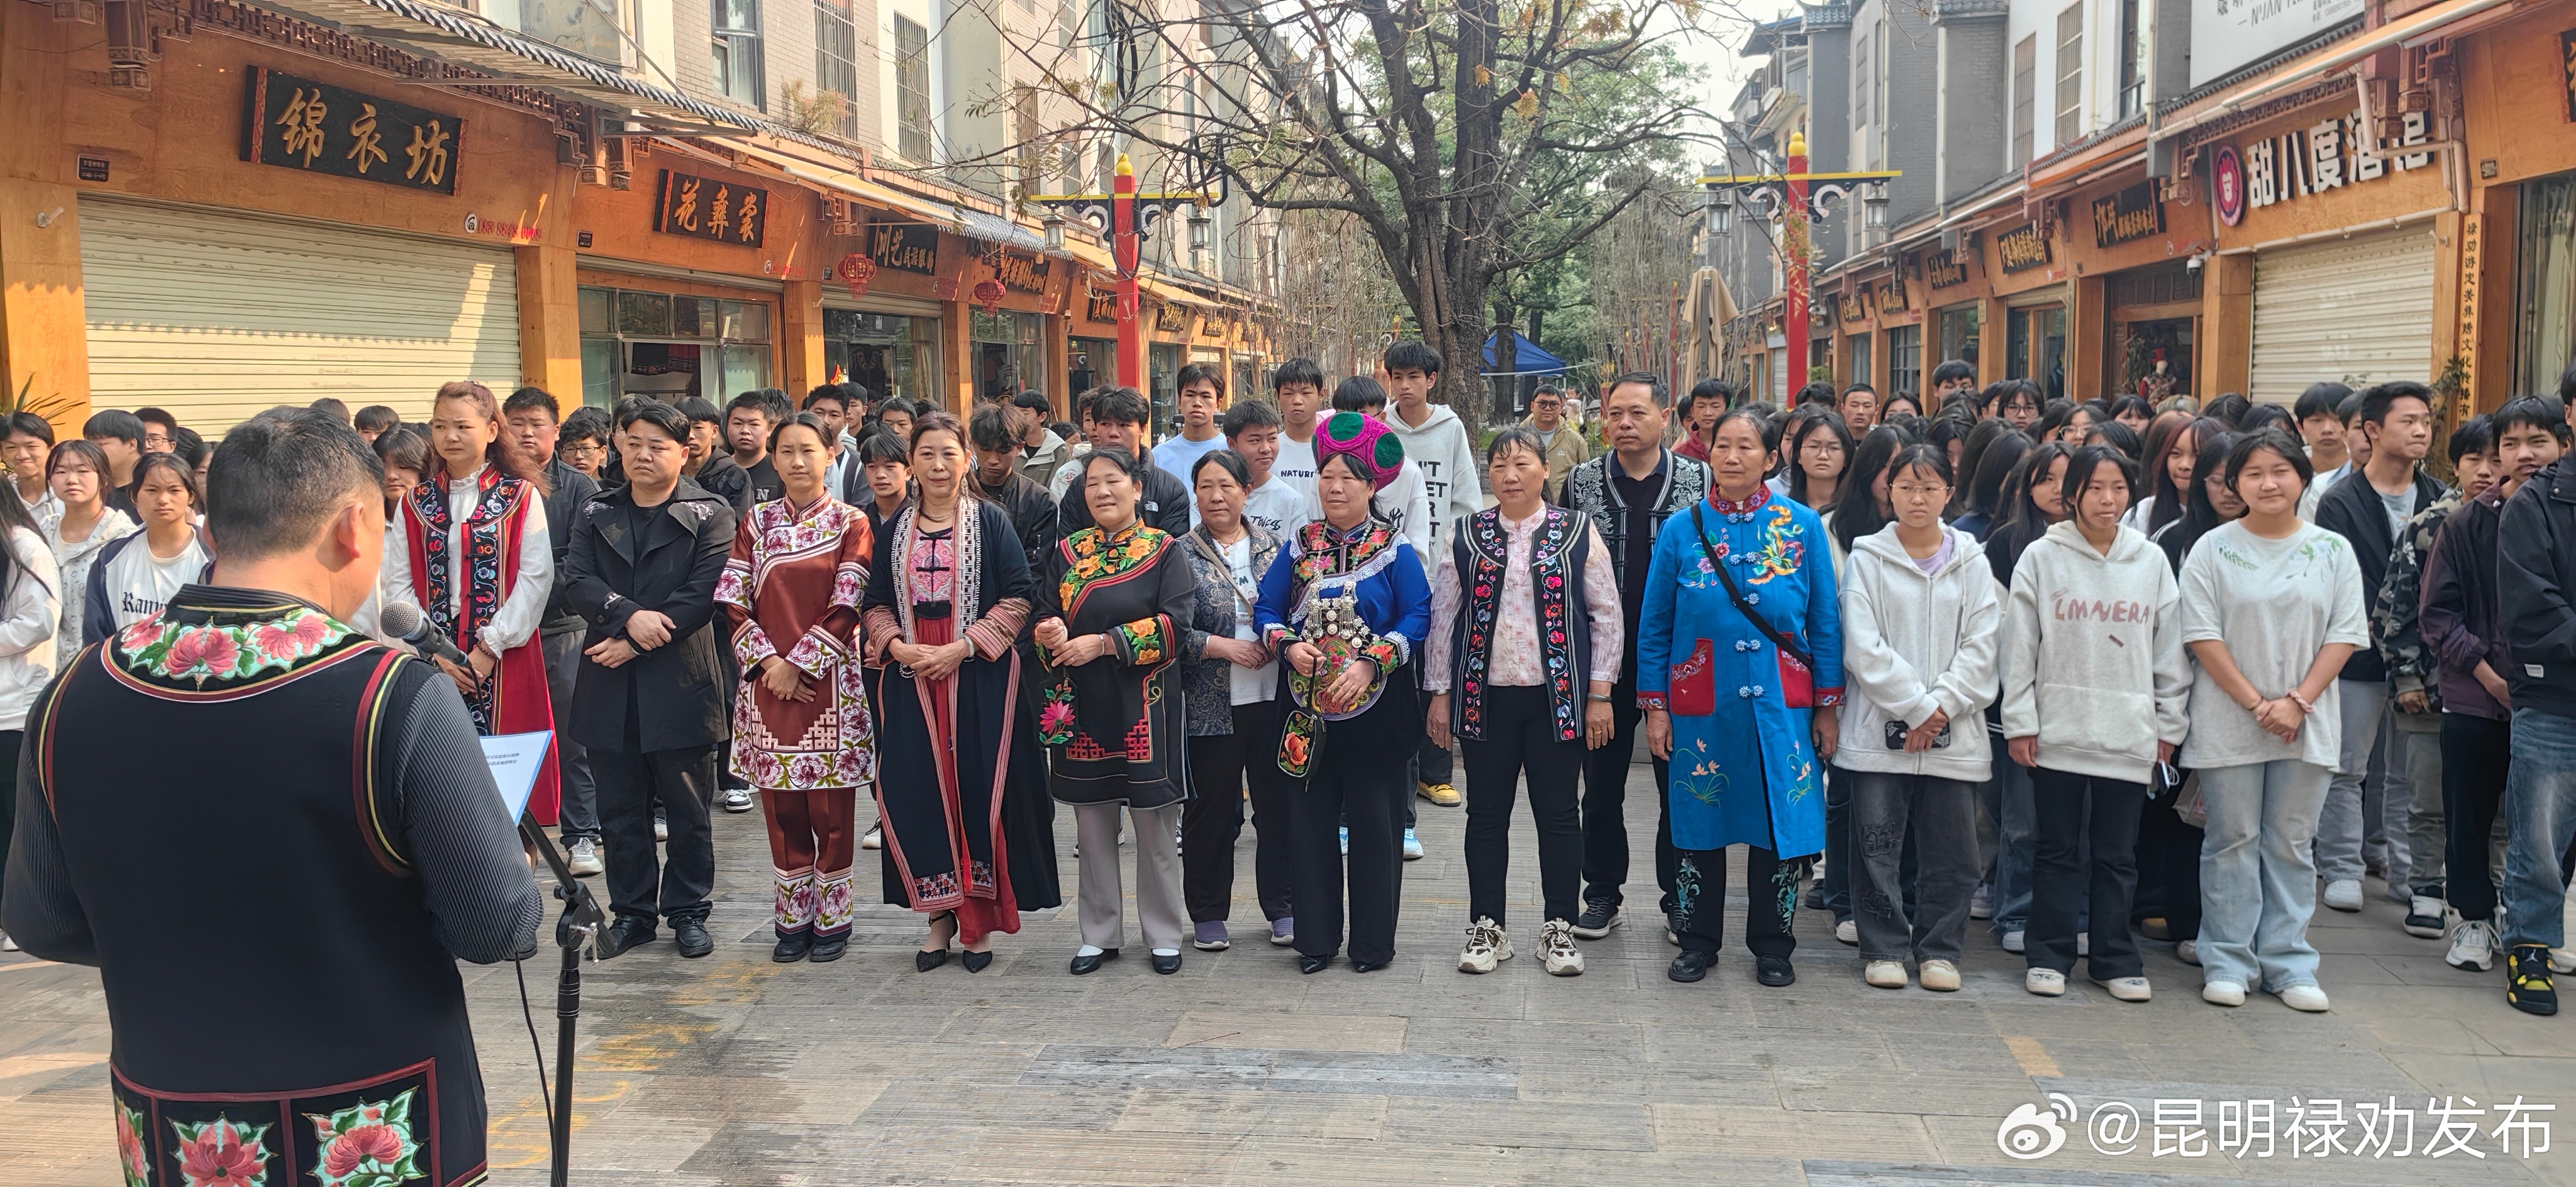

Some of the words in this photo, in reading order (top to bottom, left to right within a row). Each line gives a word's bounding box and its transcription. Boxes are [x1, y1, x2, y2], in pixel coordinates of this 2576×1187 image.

[274, 87, 449, 185] 锦衣坊
[2458, 222, 2479, 426] 禄劝游定美彝绣文化传播有
[756, 489, 770, 501] N
